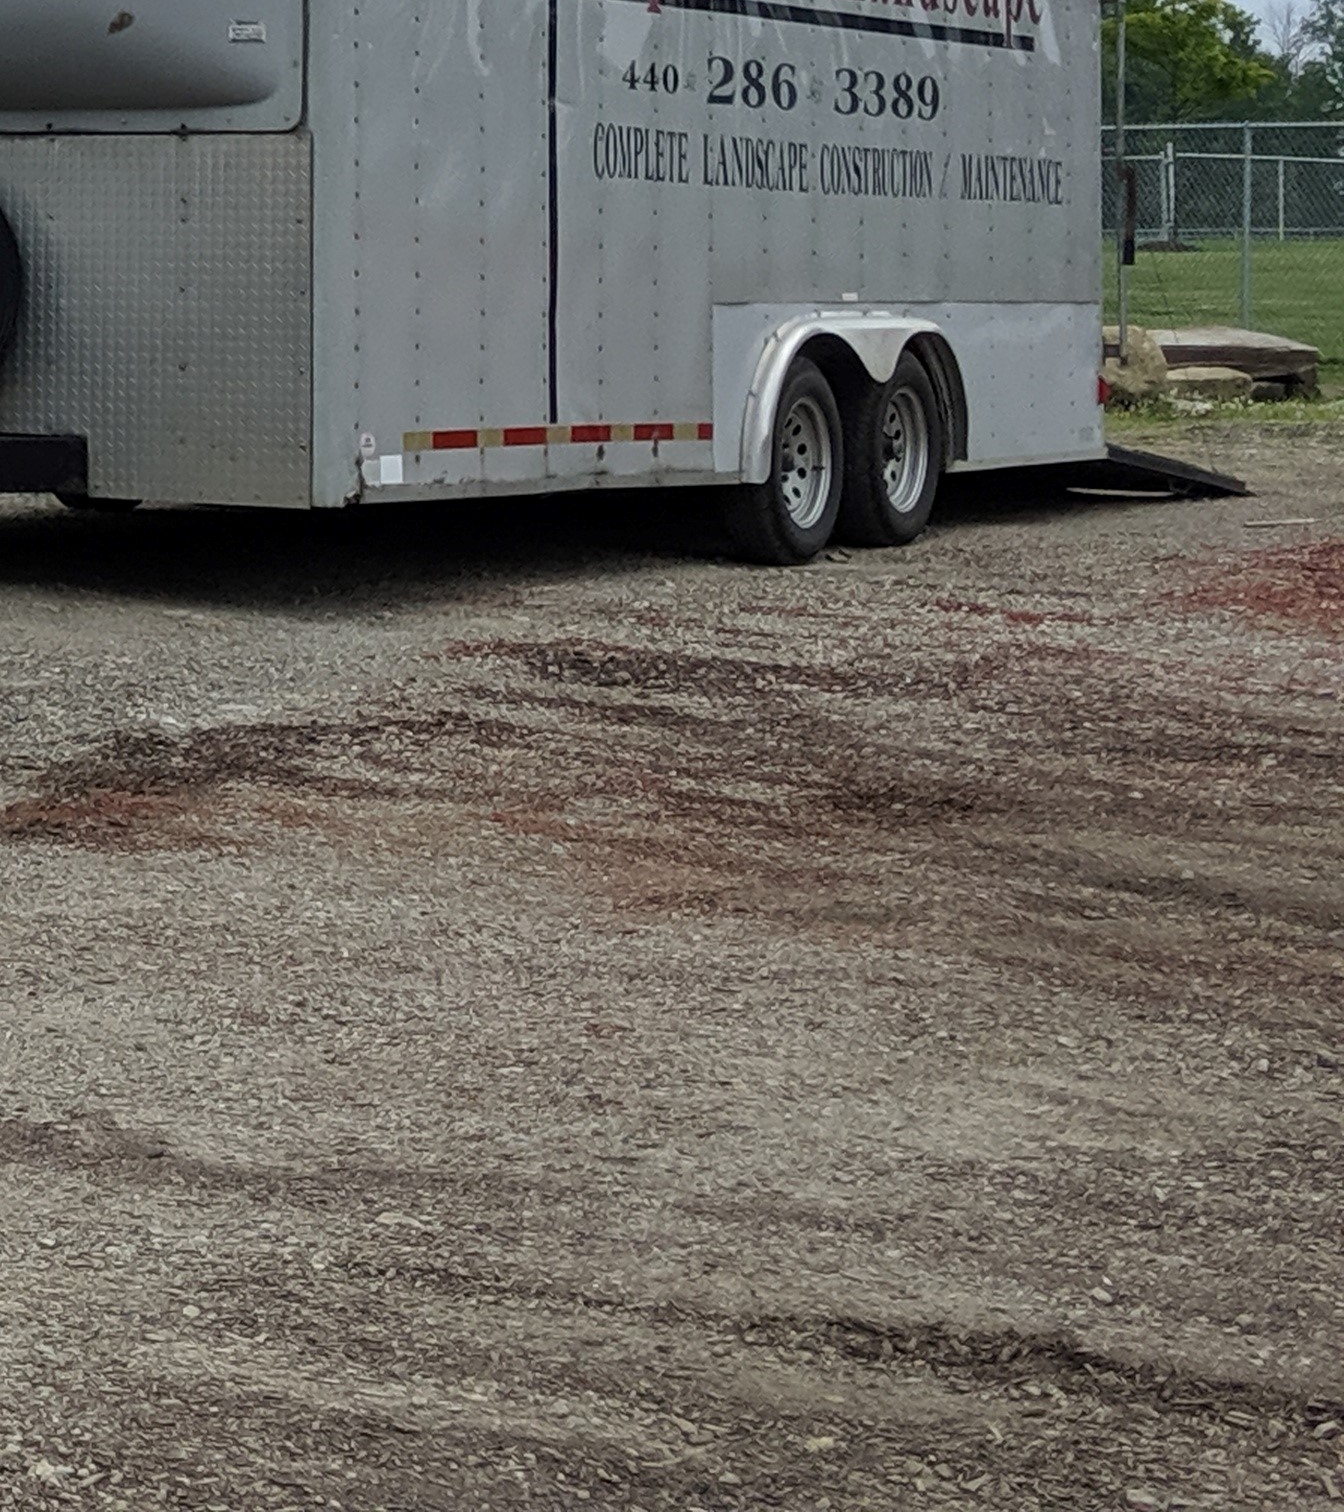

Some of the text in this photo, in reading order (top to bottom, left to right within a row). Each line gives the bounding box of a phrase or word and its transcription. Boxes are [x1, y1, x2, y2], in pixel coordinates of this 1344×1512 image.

[622, 56, 940, 121] 440 286 3389
[593, 122, 689, 185] COMPLETE
[703, 133, 809, 194] LANDSCAPE
[820, 143, 934, 199] CONSTRUCTION
